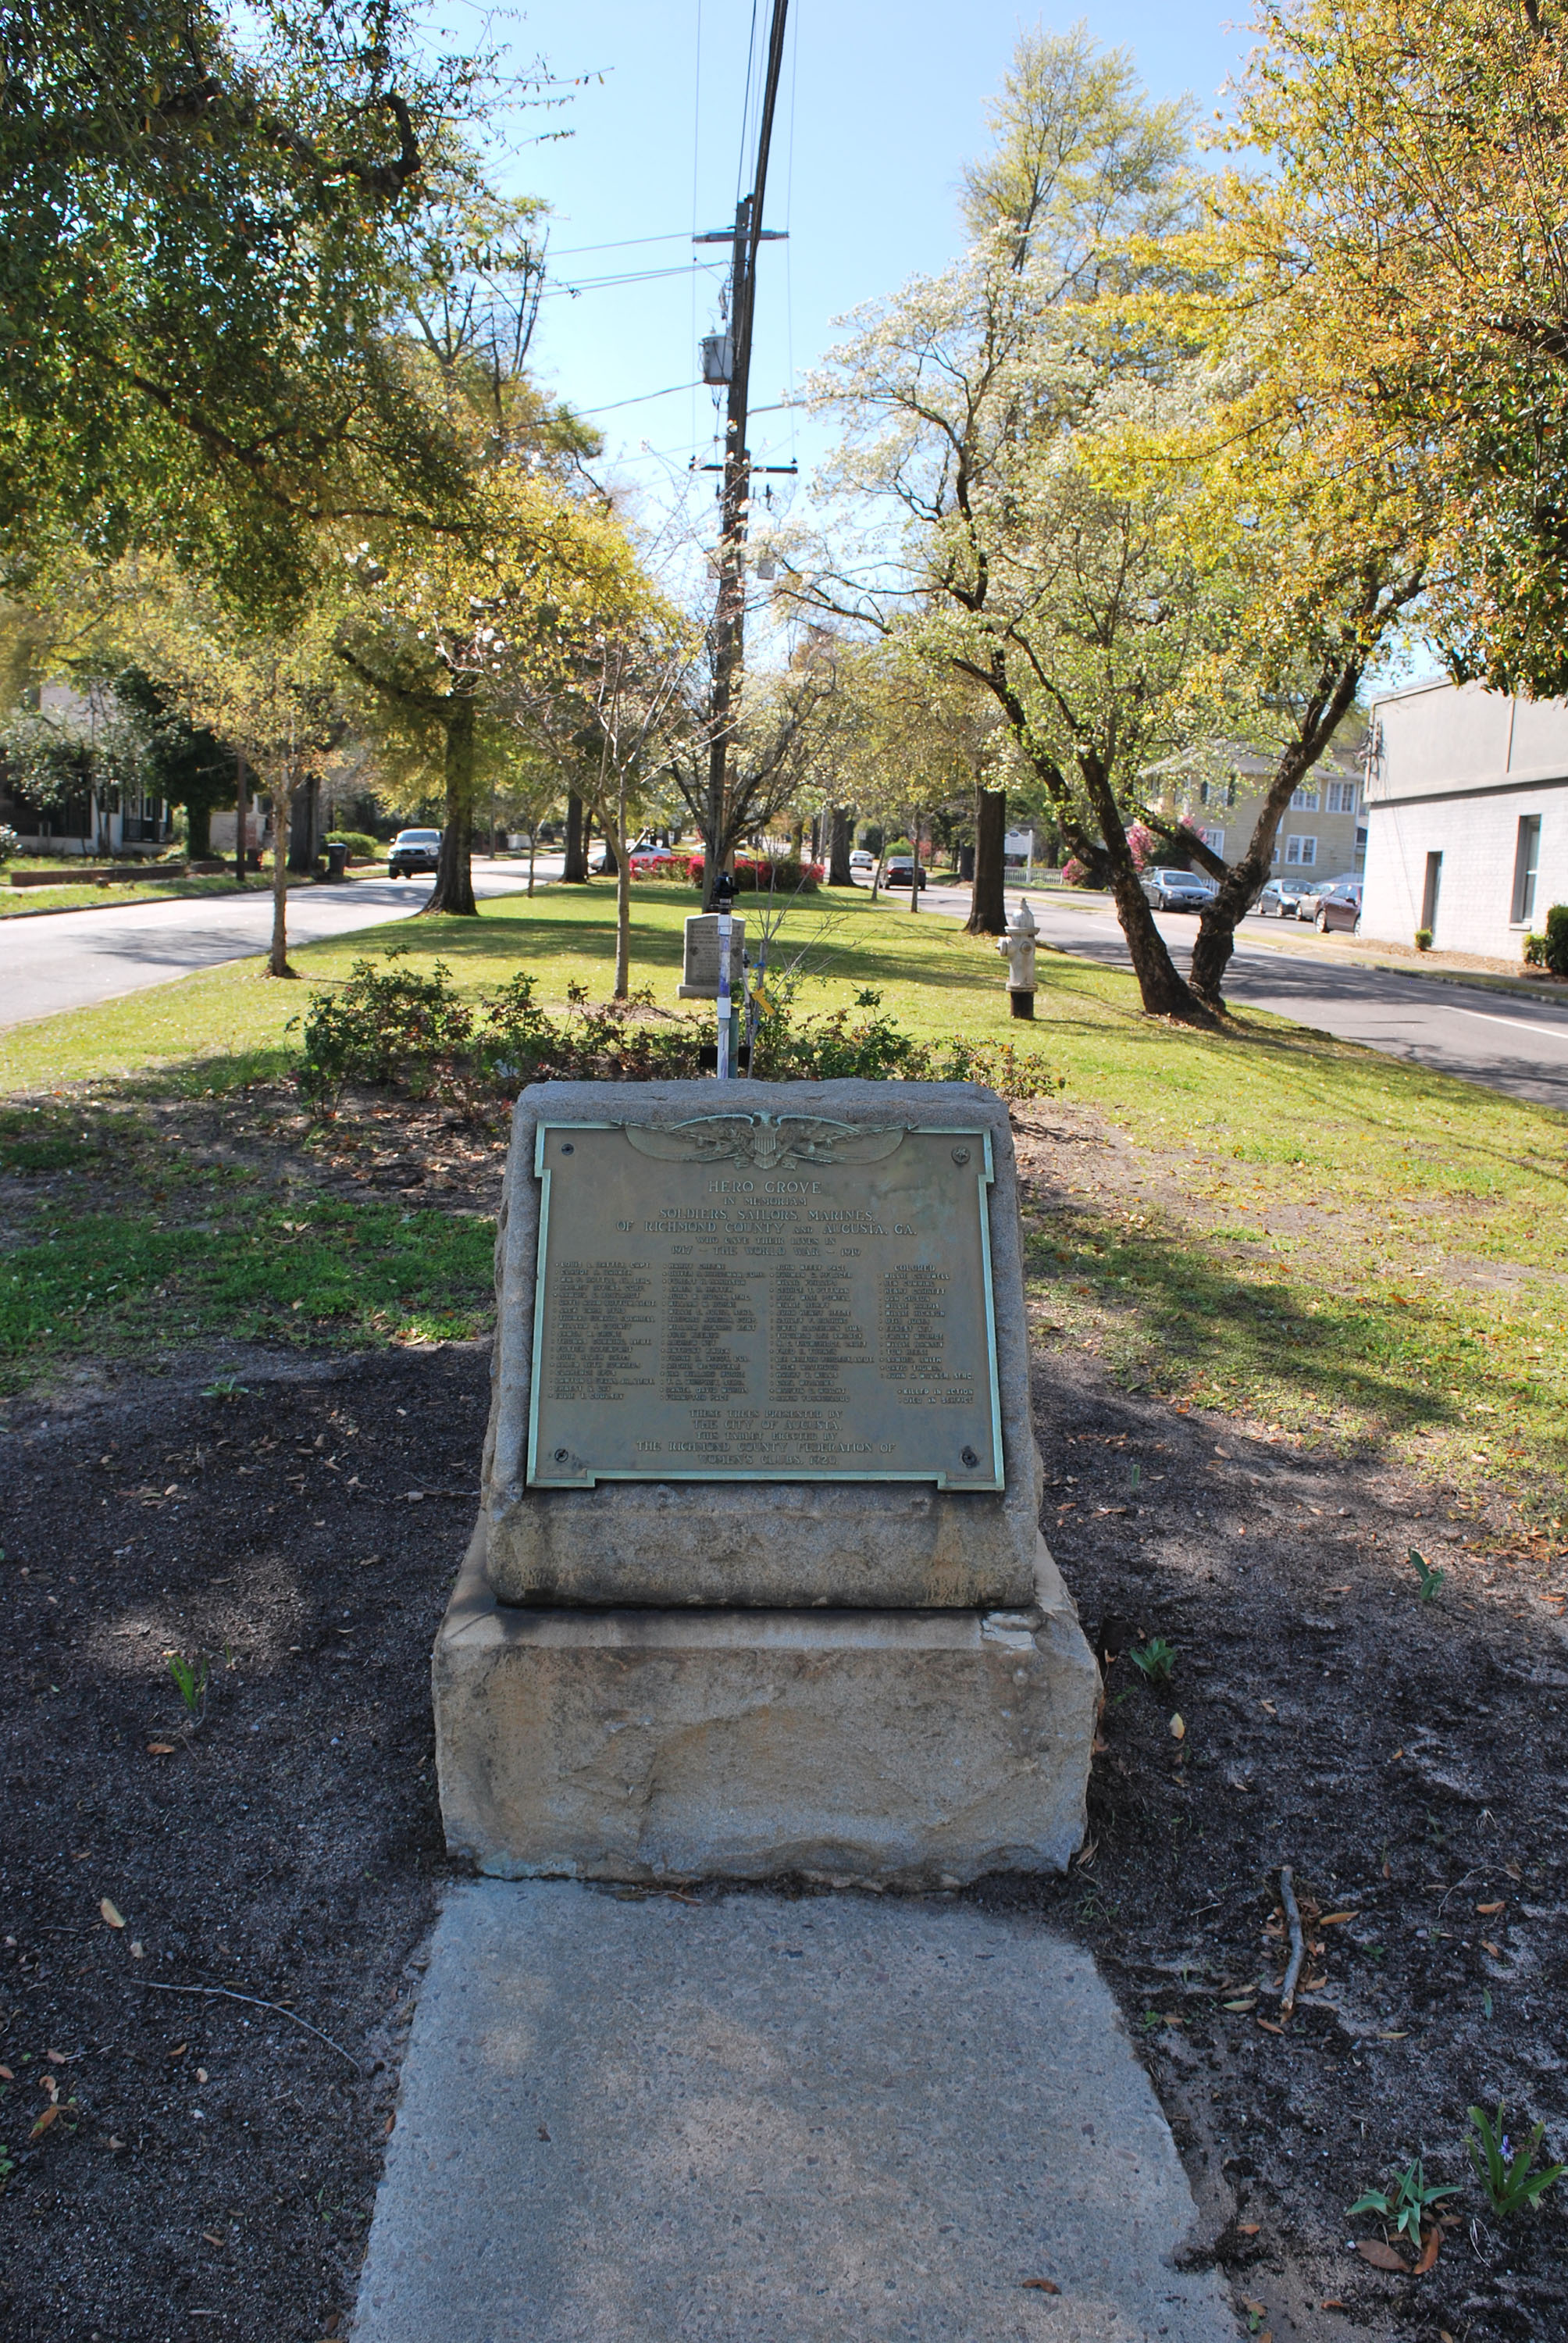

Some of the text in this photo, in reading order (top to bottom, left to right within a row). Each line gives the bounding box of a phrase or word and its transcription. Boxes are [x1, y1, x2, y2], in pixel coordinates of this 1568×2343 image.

[708, 1180, 821, 1194] HERO GROVE
[724, 1197, 807, 1206] IN MEMORIAM
[617, 1221, 634, 1232] OF
[644, 1221, 717, 1232] RICHMOND
[725, 1222, 785, 1234] COUNTY
[894, 1225, 918, 1236] GA.
[672, 1246, 693, 1255] 1917
[715, 1246, 738, 1256] THE
[746, 1247, 786, 1256] WORLD
[794, 1248, 820, 1257] WAR
[894, 1264, 936, 1272] COLORED
[903, 1388, 930, 1396] KILLED
[946, 1388, 975, 1396] ACTION
[828, 1410, 843, 1419] BY
[693, 1420, 718, 1429] THE
[725, 1420, 754, 1429] CITY
[761, 1421, 777, 1430] OF
[725, 1432, 764, 1440] TABLET
[772, 1432, 818, 1441] ERECTED
[823, 1432, 838, 1441] BY
[636, 1441, 896, 1453] THE RICHMOND COUNTY FEDERATION OF
[699, 1454, 753, 1465] WOMEN'S
